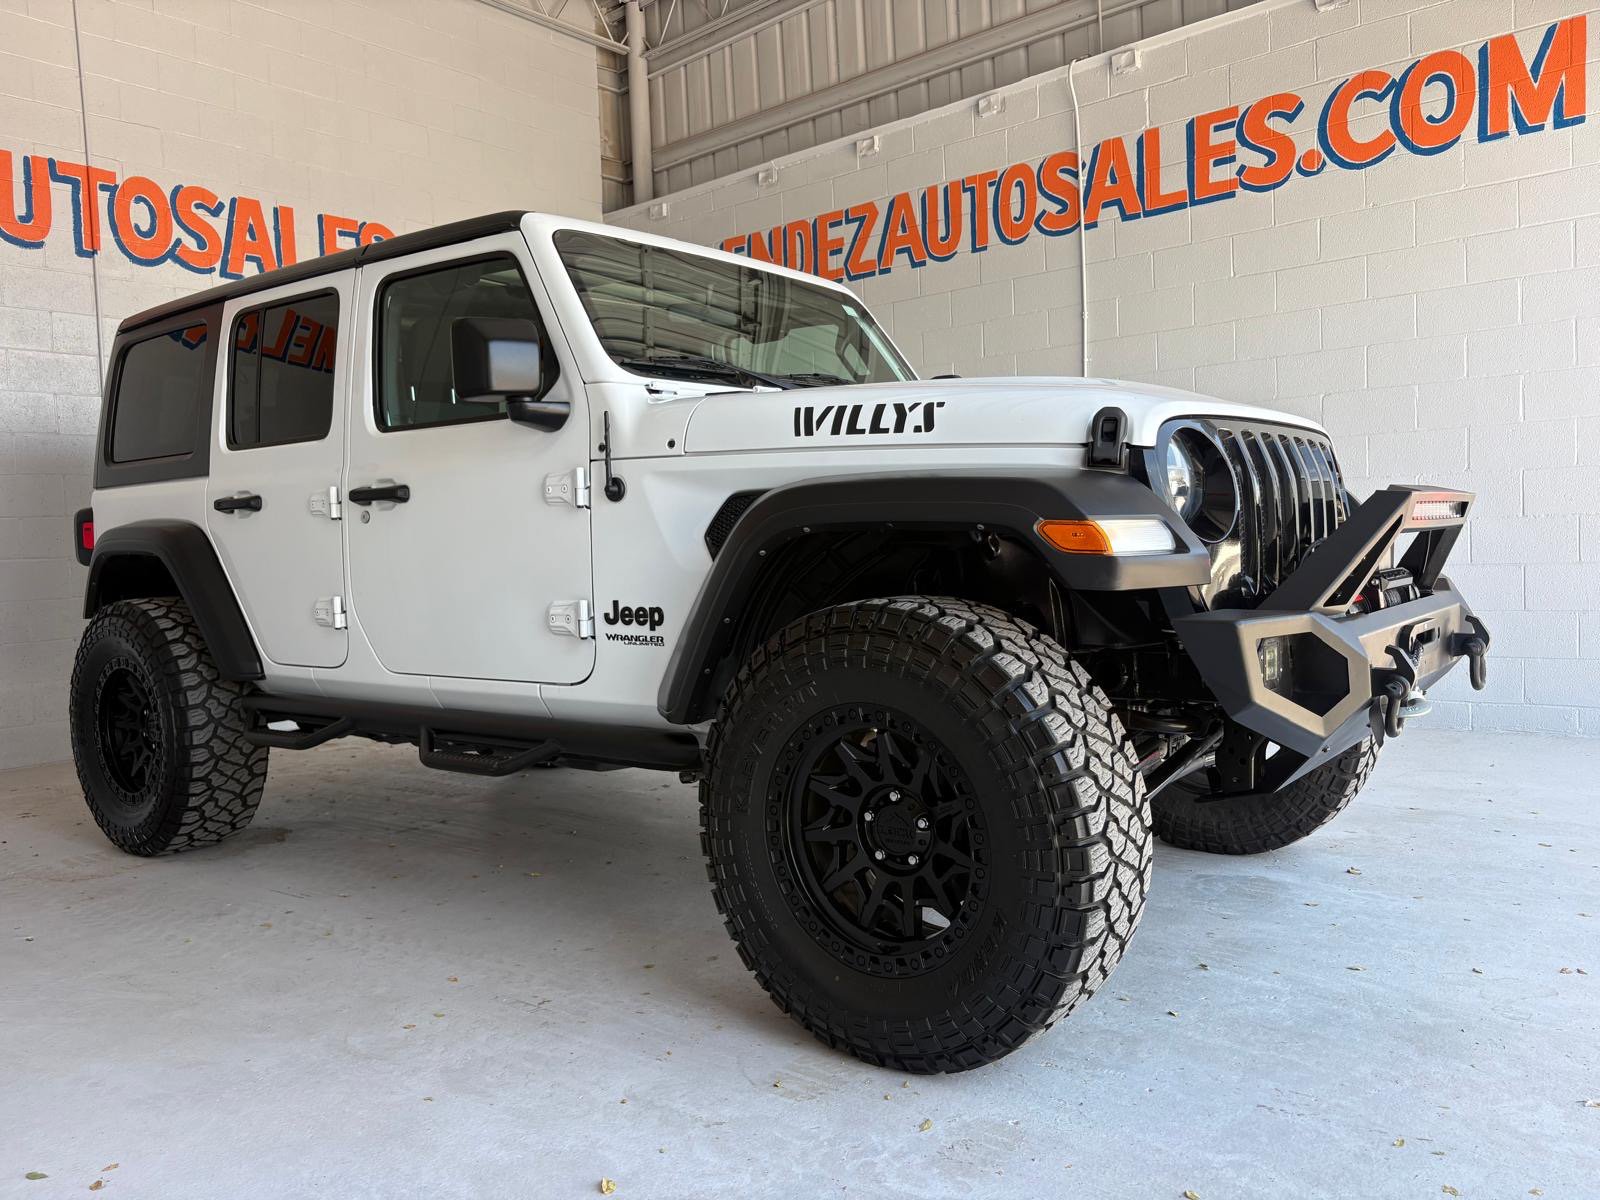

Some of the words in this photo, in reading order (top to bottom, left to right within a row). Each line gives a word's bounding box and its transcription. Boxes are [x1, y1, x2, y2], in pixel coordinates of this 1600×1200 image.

[794, 401, 946, 437] WILLYS
[603, 599, 664, 631] Jeep
[605, 633, 664, 643] WRANGLER
